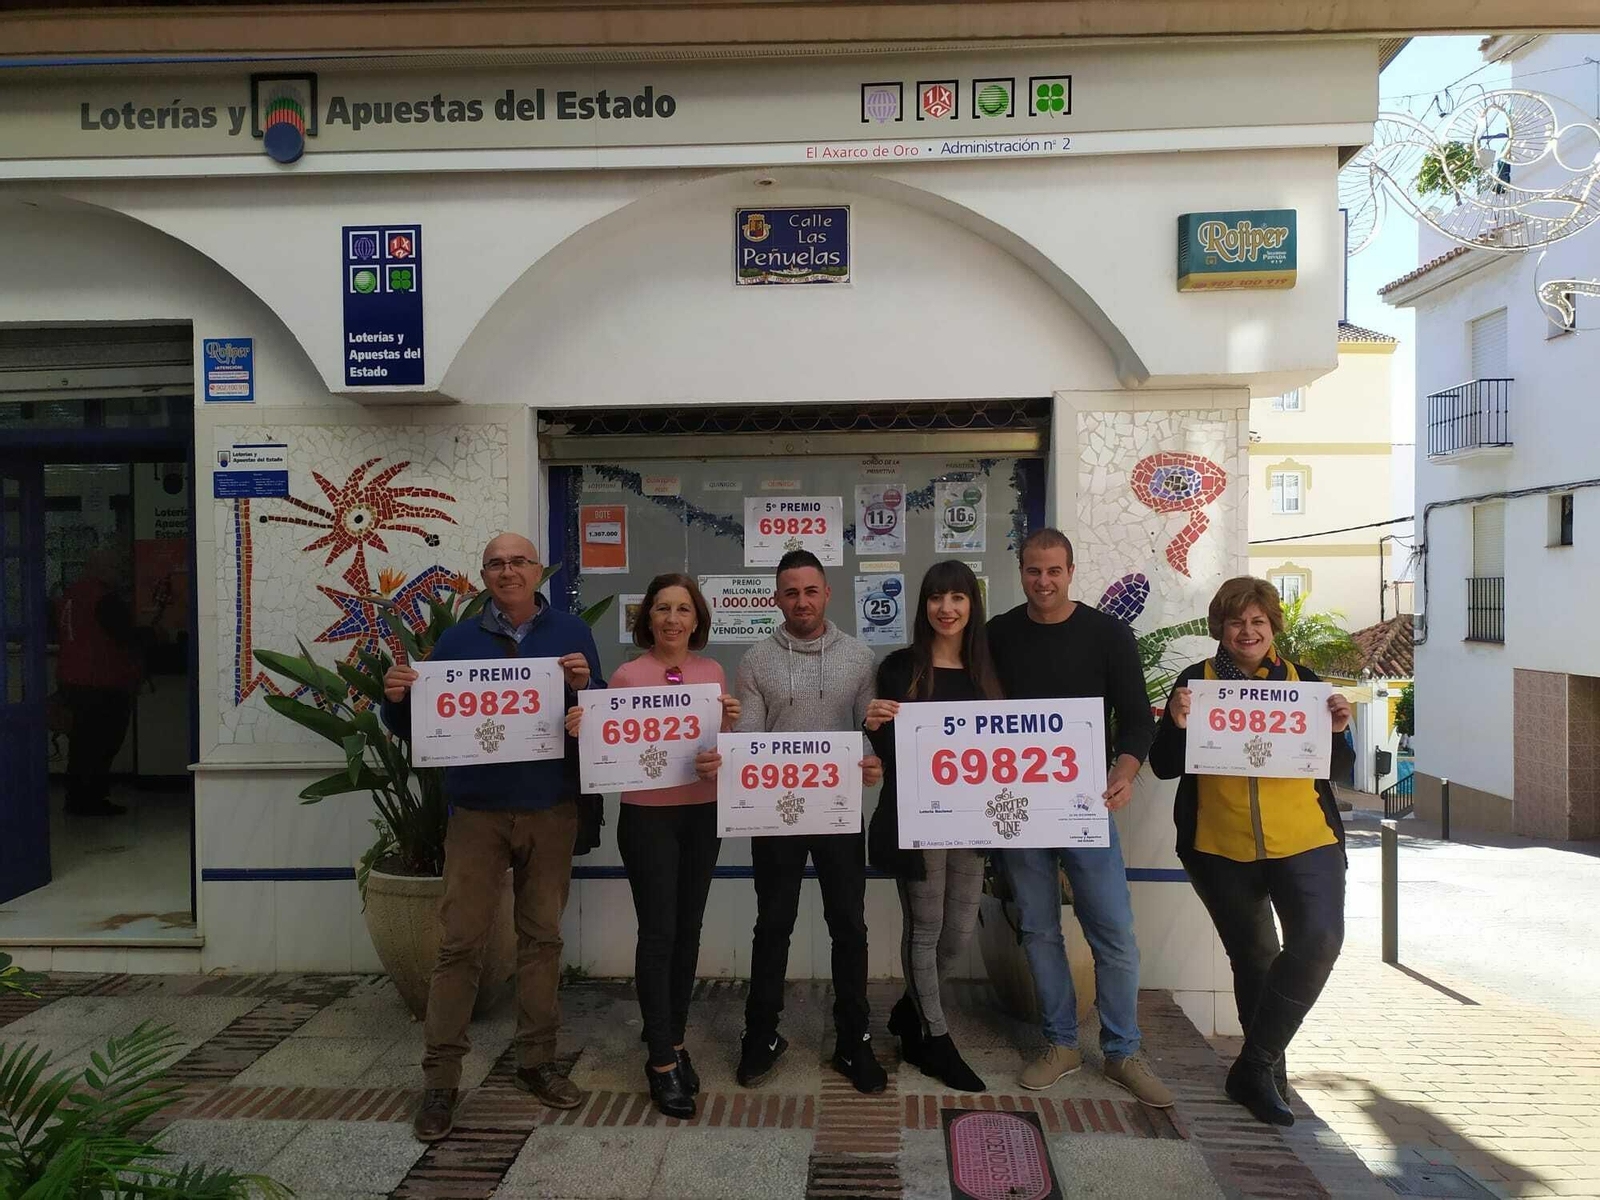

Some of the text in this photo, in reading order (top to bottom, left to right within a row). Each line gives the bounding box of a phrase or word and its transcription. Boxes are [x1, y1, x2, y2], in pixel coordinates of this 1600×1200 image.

[81, 85, 677, 136] Loterías y Apuestas del Estado
[806, 147, 818, 159] El
[822, 146, 868, 158] Axarco
[872, 145, 889, 157] de
[894, 145, 919, 156] Oro
[940, 139, 1040, 155] Administración
[1062, 137, 1071, 150] 2
[789, 213, 832, 227] Calle
[797, 230, 827, 243] Las
[744, 246, 841, 266] Peñuelas
[349, 331, 404, 344] Loterías y
[349, 348, 421, 362] Apuestas del
[350, 366, 388, 377] Estado
[780, 502, 821, 512] PREMIO
[759, 518, 827, 535] 69823
[722, 587, 771, 595] MILLONARIO
[870, 600, 891, 615] 25
[712, 627, 754, 635] VENDIDO
[469, 667, 531, 682] PREMIO
[436, 688, 541, 718] 69823
[632, 693, 691, 709] PREMIO
[1240, 688, 1299, 702] PREMIO
[976, 713, 1063, 734] PREMIO
[1209, 708, 1307, 734] 69823
[602, 715, 701, 745] 69823
[772, 740, 831, 754] PREMIO
[932, 745, 1079, 785] 69823
[741, 763, 840, 790] 69823
[985, 797, 1029, 818] SORTEO
[992, 821, 1021, 840] UNE
[984, 1129, 1011, 1182] INCENDIOS
